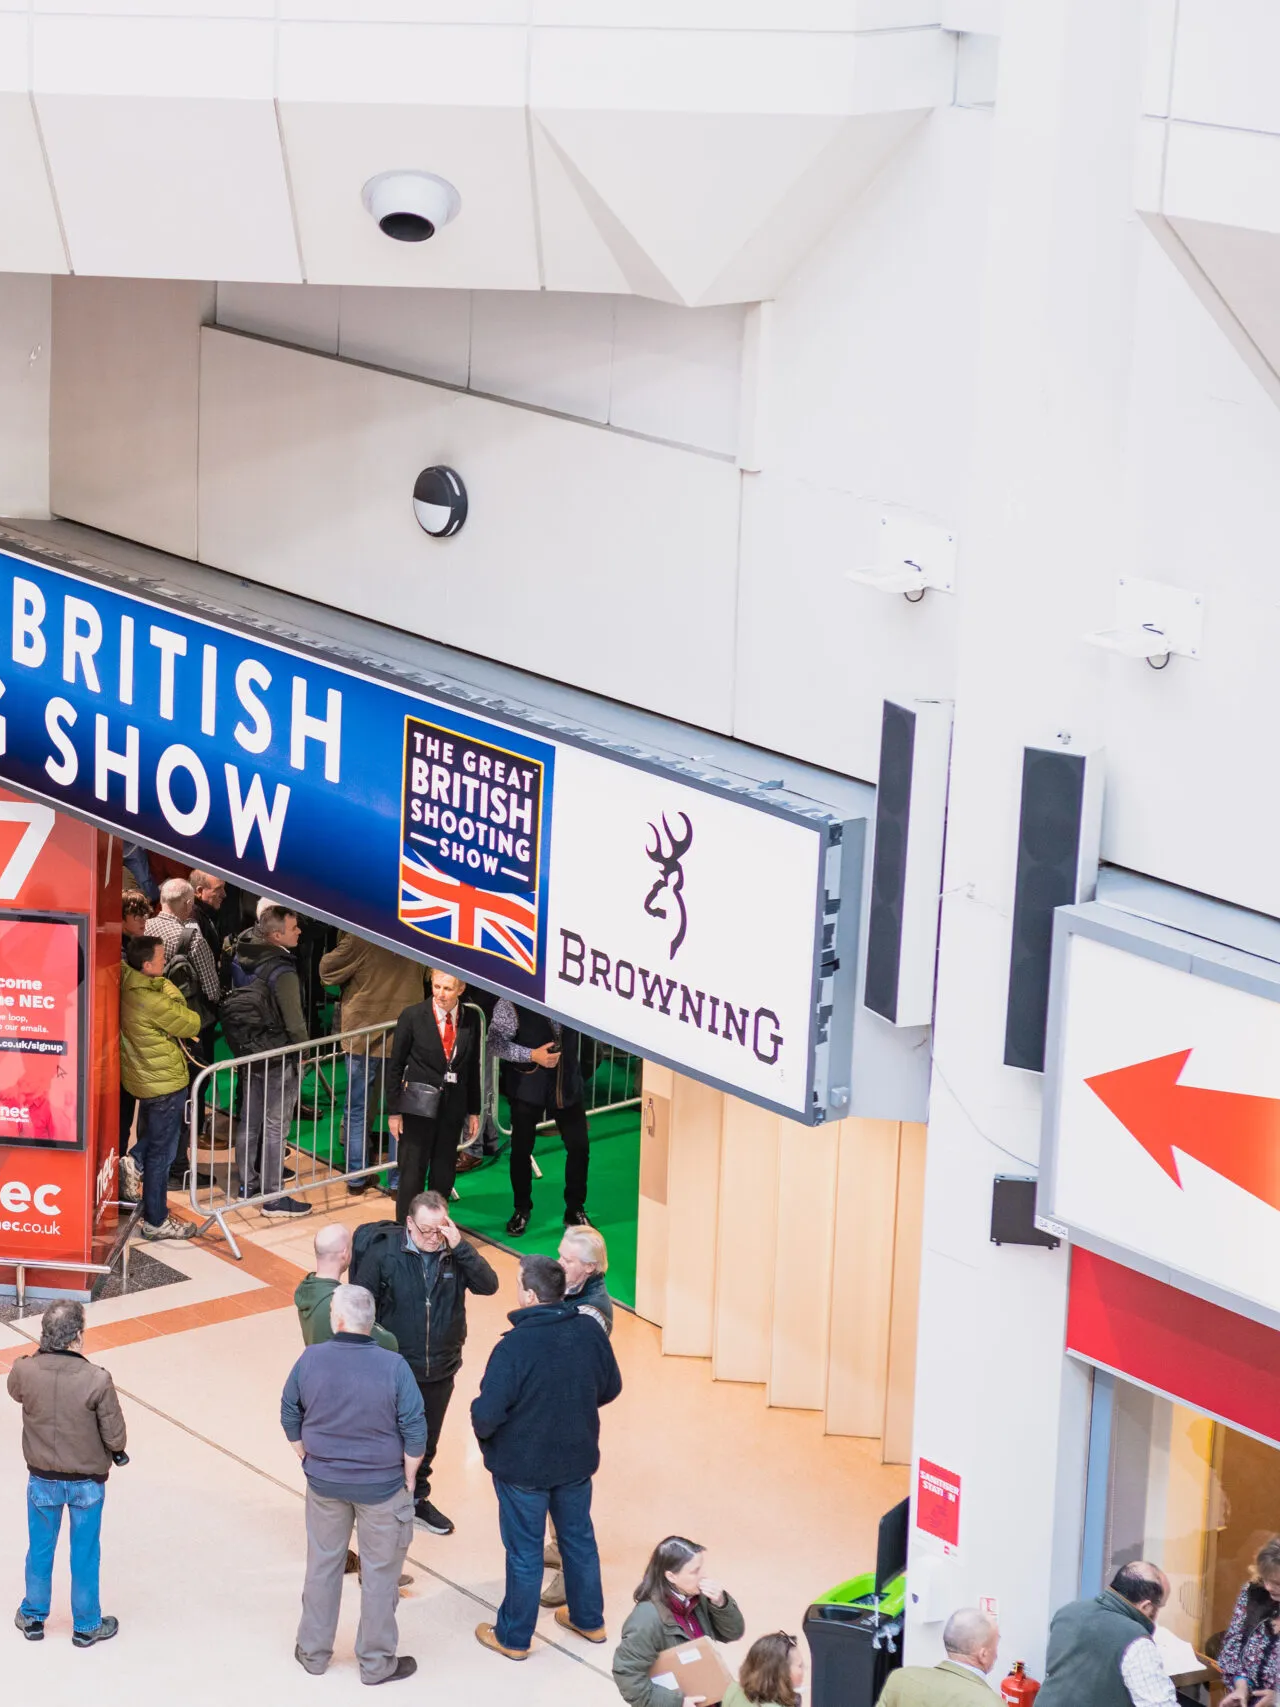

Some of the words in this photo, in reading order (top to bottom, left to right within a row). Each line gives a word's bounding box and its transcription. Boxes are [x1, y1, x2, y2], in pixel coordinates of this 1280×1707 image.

[12, 576, 342, 784] BRITISH
[44, 696, 291, 872] SHOW
[413, 731, 454, 765] THE
[462, 750, 534, 793] GREAT
[411, 757, 533, 835] BRITISH
[410, 798, 531, 862] SHOOTING
[439, 837, 499, 876] SHOW
[8, 1013, 29, 1023] loop,
[19, 994, 55, 1009] NEC
[558, 928, 784, 1066] BROWNING
[20, 1024, 49, 1033] emails.
[0, 1105, 30, 1118] nec
